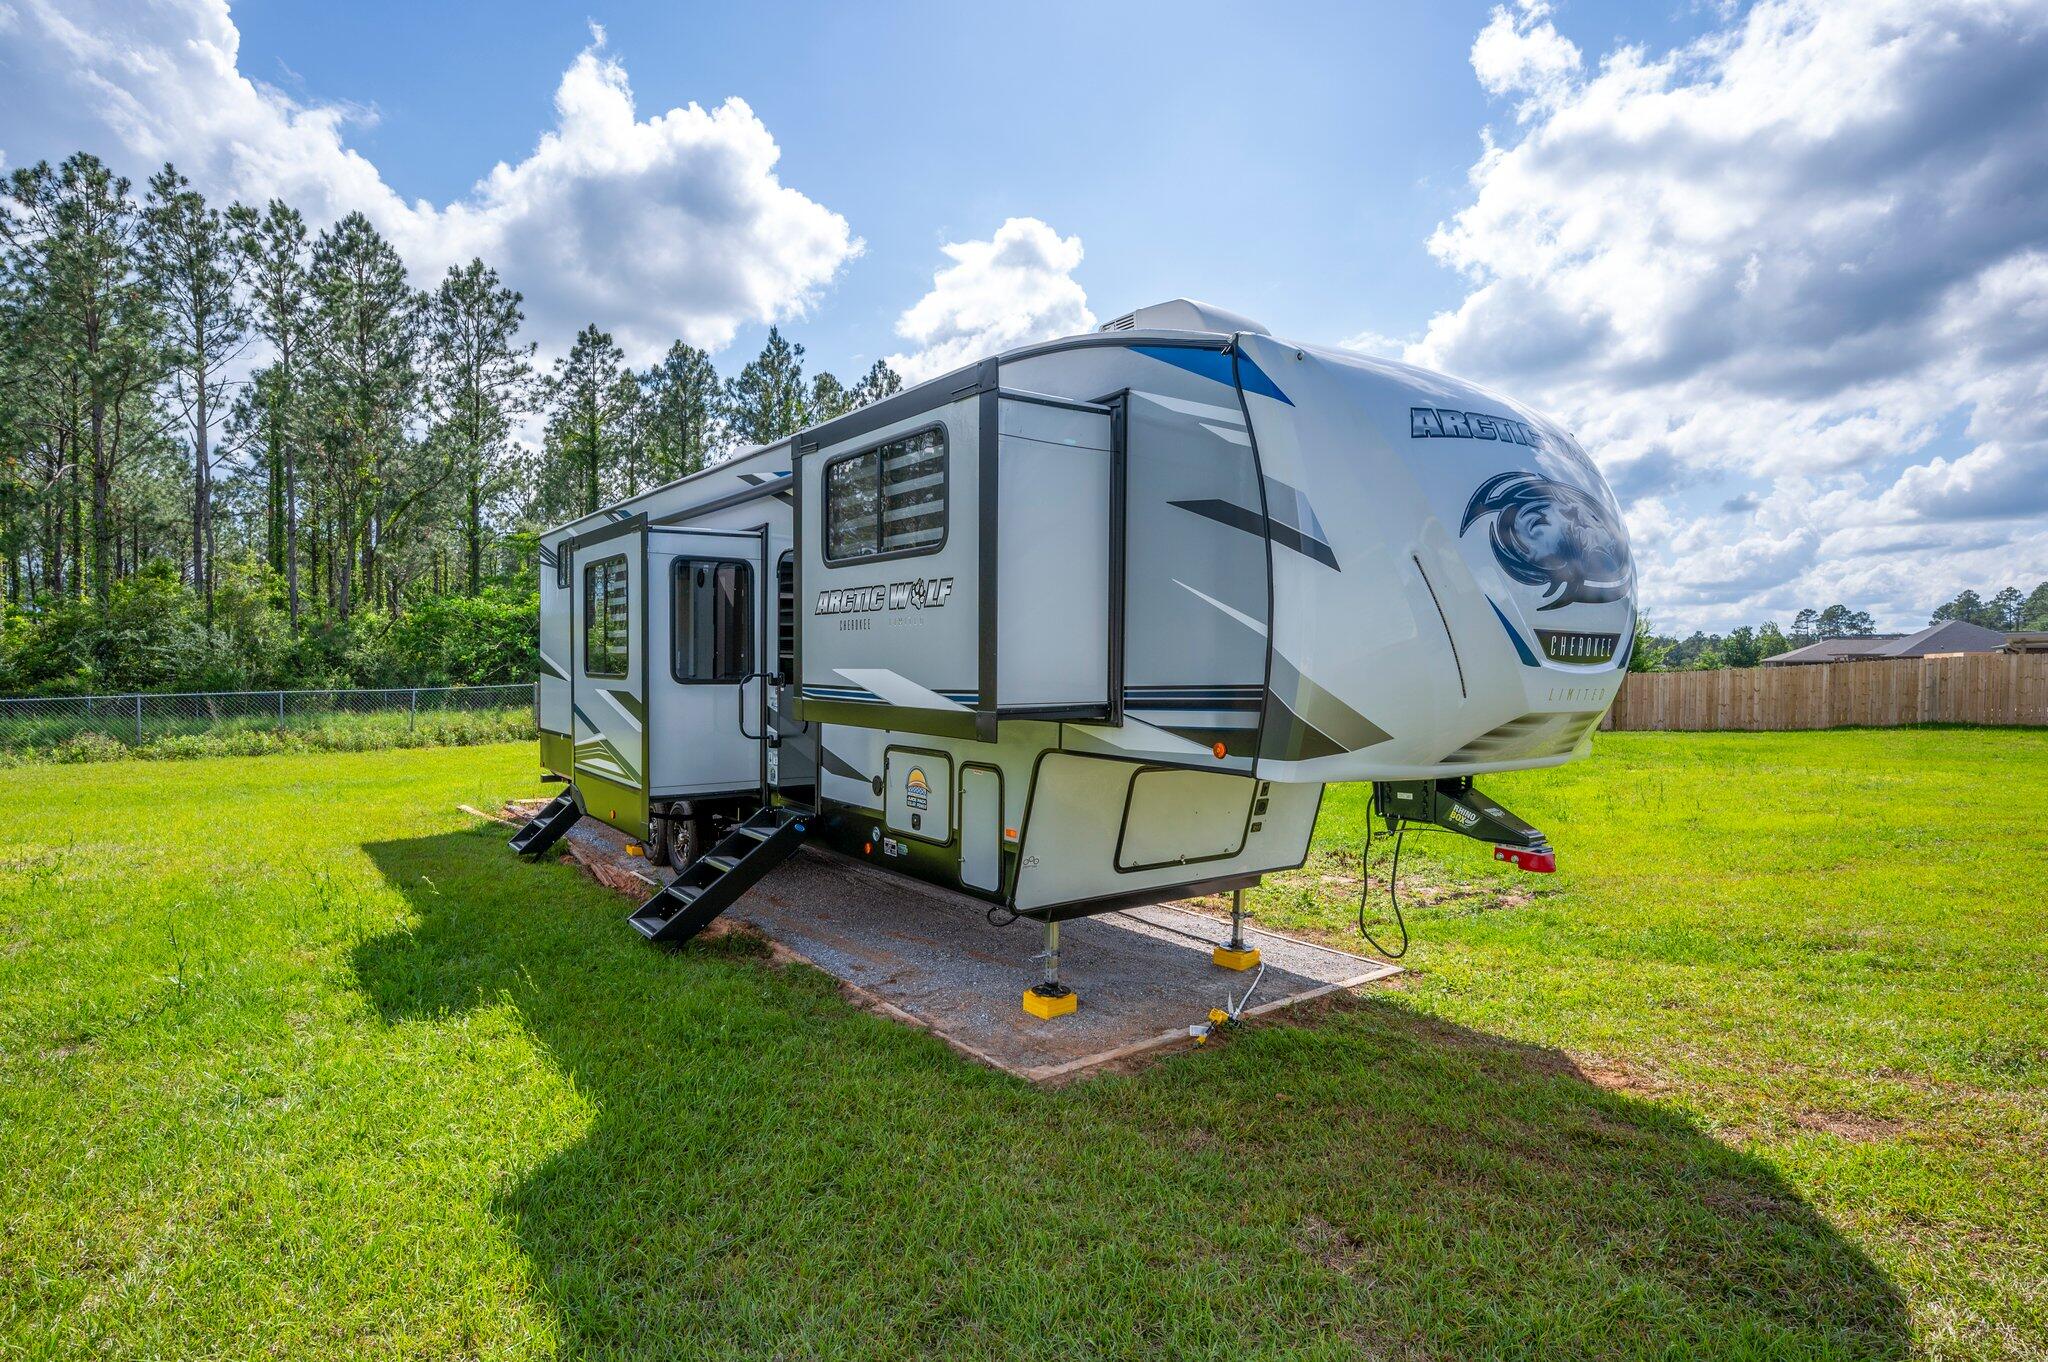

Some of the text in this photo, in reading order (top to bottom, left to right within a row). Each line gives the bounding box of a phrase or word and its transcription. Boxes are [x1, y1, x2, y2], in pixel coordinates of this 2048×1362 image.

[1410, 407, 1546, 449] ARCTIC
[814, 585, 886, 615] ARCTIC
[839, 618, 871, 631] CHEROKEE
[1550, 635, 1612, 657] CHEROKEE
[1548, 687, 1605, 701] LIMITED
[1450, 810, 1466, 824] BOX
[1453, 804, 1476, 821] RHINO
